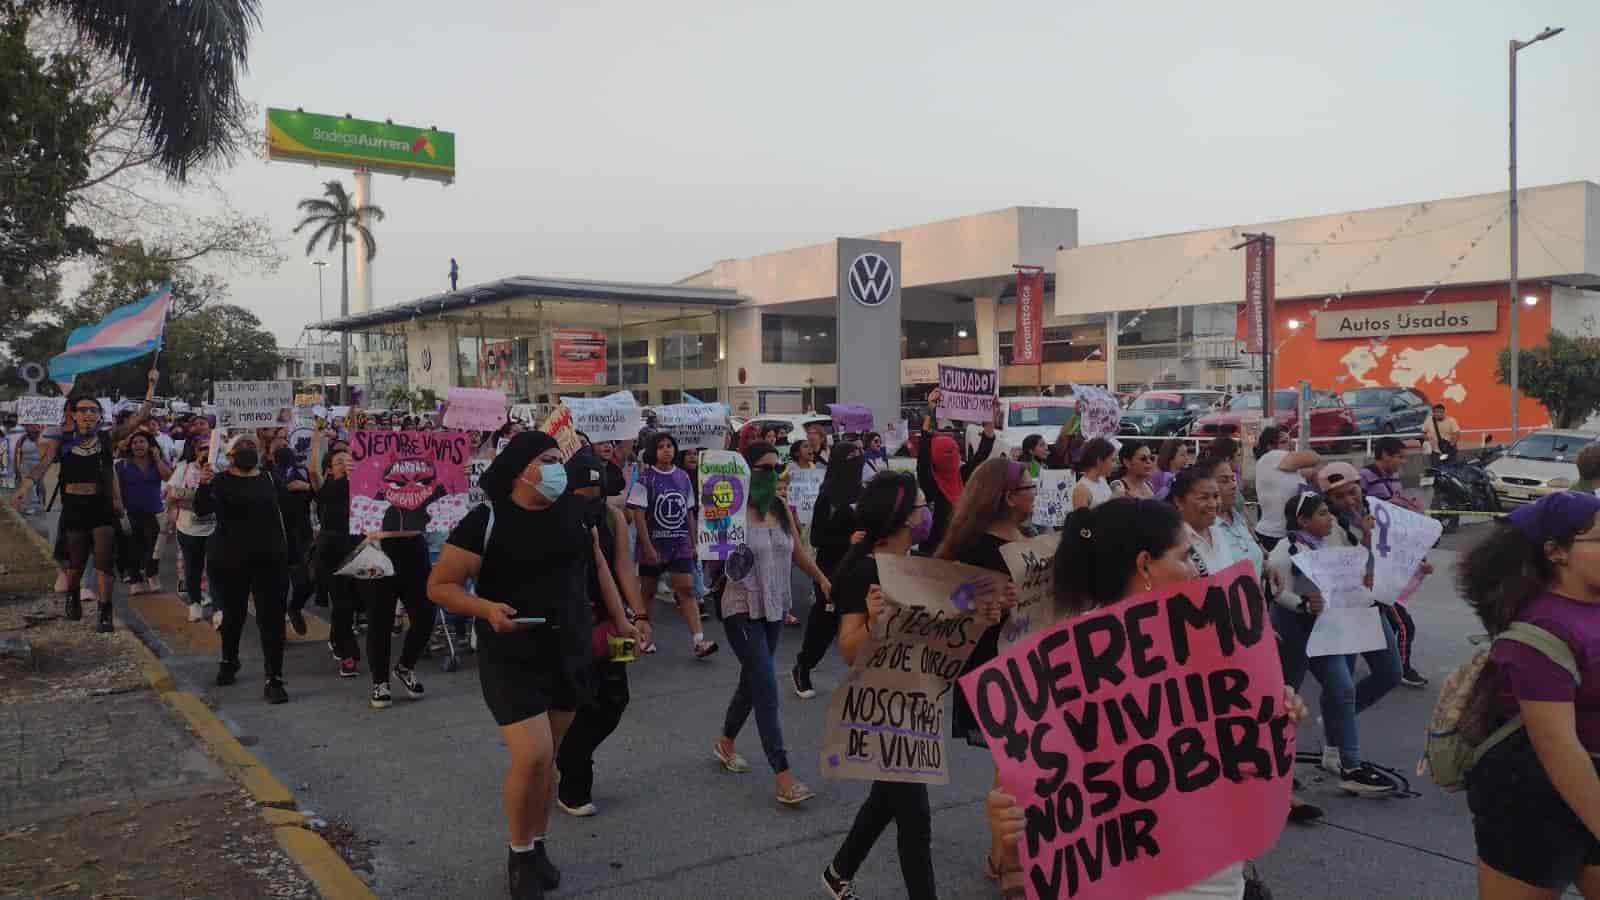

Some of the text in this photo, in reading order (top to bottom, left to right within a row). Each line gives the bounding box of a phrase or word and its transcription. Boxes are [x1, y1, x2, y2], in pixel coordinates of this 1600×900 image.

[1339, 310, 1470, 333] Autos Usados
[940, 368, 996, 393] ¡CUIDADO!
[351, 431, 466, 465] SIEMPRE VIVAS
[976, 574, 1264, 762] QUEREMO
[841, 685, 943, 736] NOSOTRAS
[848, 728, 869, 758] DE
[1031, 722, 1069, 798] S
[1024, 782, 1084, 859] NO
[1030, 808, 1161, 900] VIVIR
